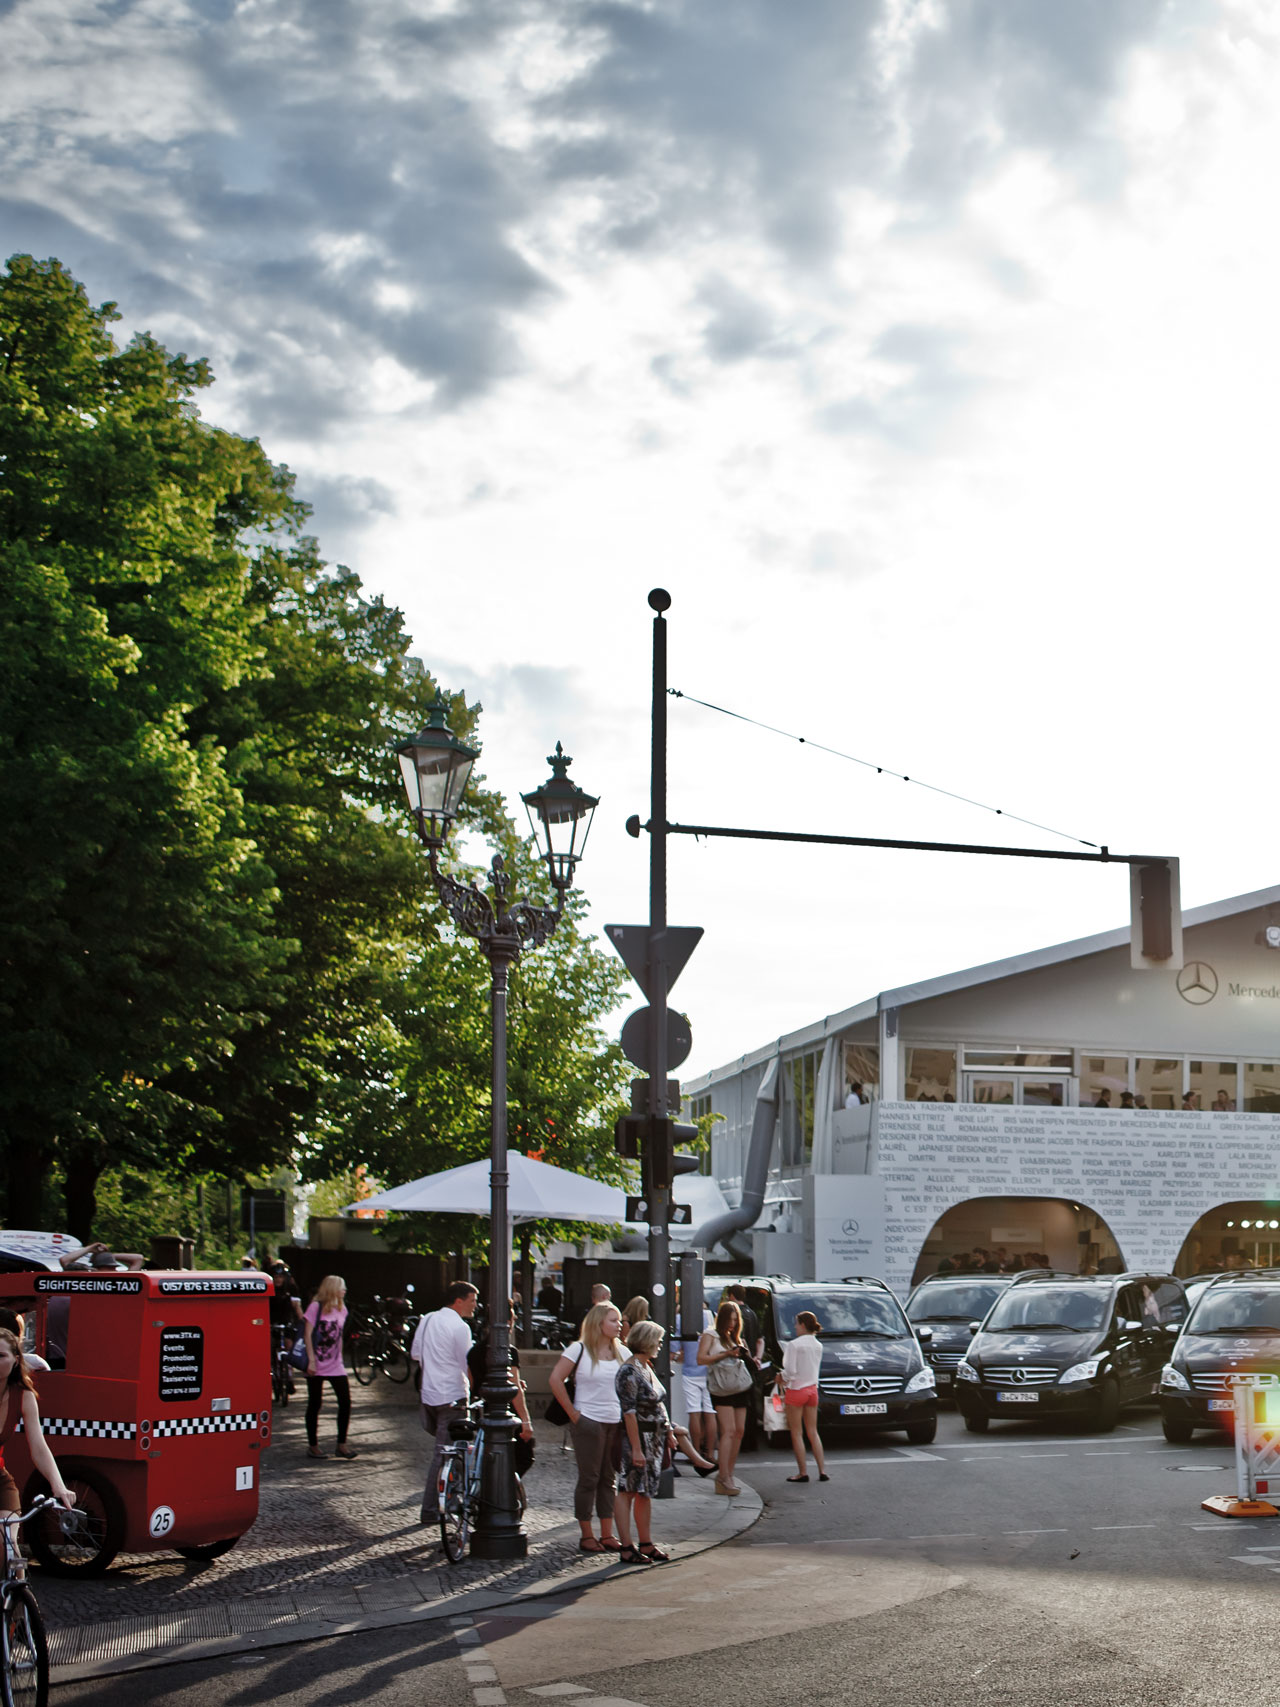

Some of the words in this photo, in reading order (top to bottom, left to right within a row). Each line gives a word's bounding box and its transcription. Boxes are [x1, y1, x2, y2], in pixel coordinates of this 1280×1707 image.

[879, 1102, 916, 1110] AUSTRIAN
[921, 1104, 953, 1112] FASHION
[879, 1122, 921, 1131] STRENESSE
[1066, 1118, 1107, 1127] PRESENTED
[1120, 1120, 1177, 1129] MERCEDES-BENZ
[959, 1125, 998, 1133] ROMANIAN
[1004, 1126, 1045, 1135] DESIGNERS
[936, 1134, 980, 1143] TOMORROW
[956, 1145, 997, 1154] DESIGNERS
[39, 1280, 139, 1291] SIGHTSEEING-TAXI
[162, 1282, 182, 1291] 0157
[184, 1282, 202, 1291] 876
[203, 1282, 210, 1290] 2
[211, 1281, 232, 1290] 3333
[239, 1281, 265, 1290] 3TX.eu
[163, 1344, 185, 1352] Events
[243, 1471, 247, 1485] 1
[153, 1513, 170, 1532] 25
